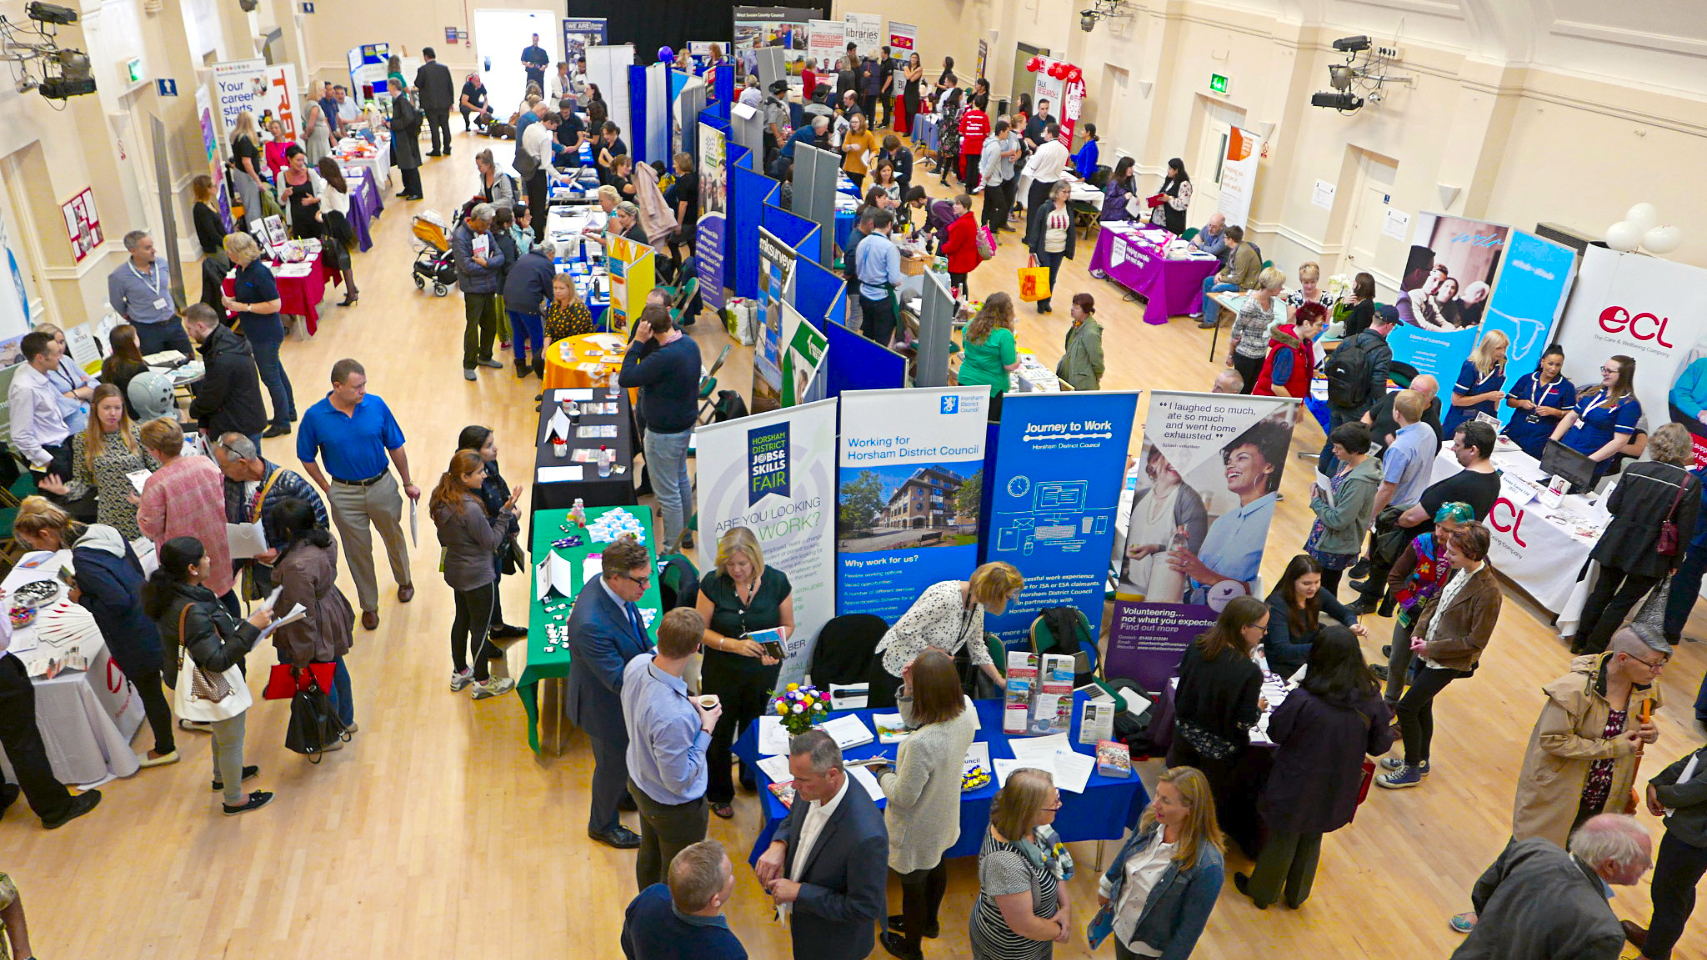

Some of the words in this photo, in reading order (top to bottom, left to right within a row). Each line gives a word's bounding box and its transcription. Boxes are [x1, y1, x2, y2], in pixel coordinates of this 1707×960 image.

[846, 28, 878, 40] libraries
[218, 81, 244, 92] Your
[221, 93, 254, 104] career
[223, 104, 253, 115] starts
[760, 238, 794, 272] mksurveys
[1174, 402, 1212, 413] laughed
[1228, 407, 1256, 416] much,
[1167, 412, 1182, 420] ate
[1198, 414, 1224, 423] much
[1025, 423, 1067, 433] Journey
[1070, 421, 1081, 430] to
[1084, 420, 1112, 430] Work
[1210, 424, 1236, 433] home
[752, 432, 786, 445] HORSHAM
[848, 438, 892, 447] Working
[895, 436, 910, 445] for
[752, 440, 786, 454] DISTRICT
[848, 449, 895, 460] Horsham
[900, 447, 936, 457] District
[940, 445, 979, 455] Council
[752, 459, 786, 476] SKILLS
[753, 471, 786, 493] FAIR
[716, 517, 740, 533] ARE
[743, 511, 768, 526] YOU
[771, 496, 821, 519] LOOKING
[758, 511, 821, 541] WORK?
[1490, 497, 1526, 548] CL
[845, 559, 863, 568] Why
[866, 558, 886, 566] work
[889, 556, 901, 564] for
[1003, 638, 1018, 646] your
